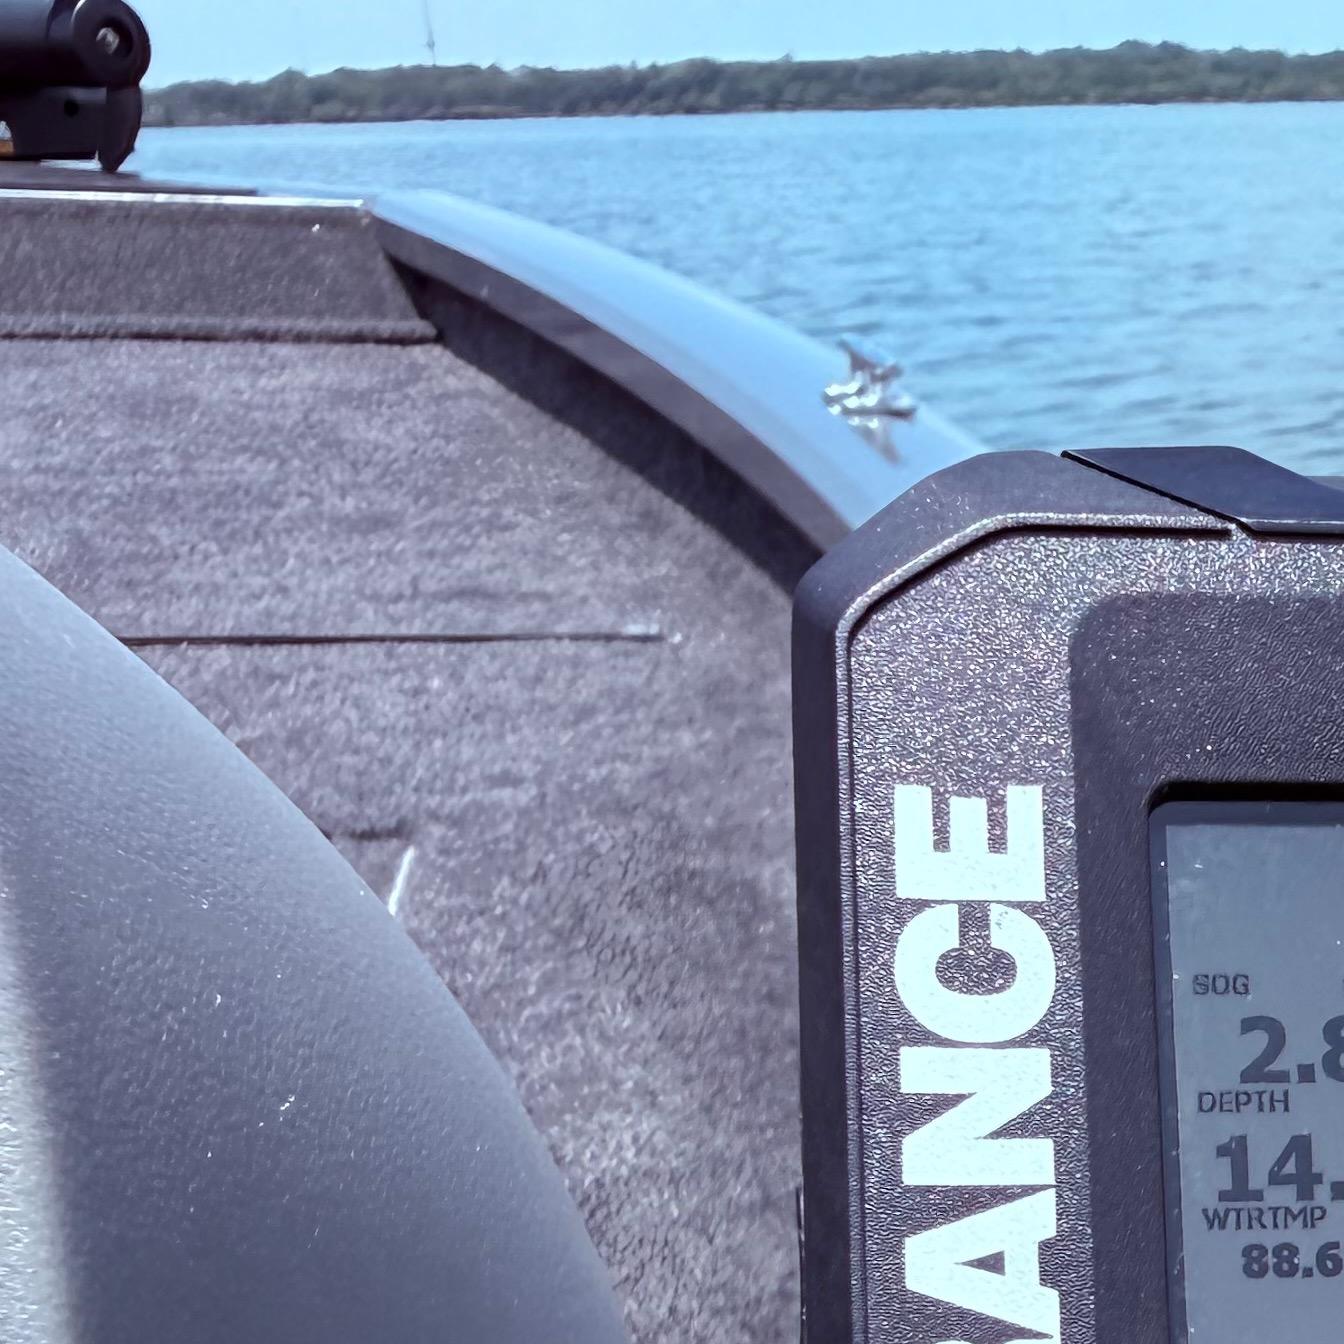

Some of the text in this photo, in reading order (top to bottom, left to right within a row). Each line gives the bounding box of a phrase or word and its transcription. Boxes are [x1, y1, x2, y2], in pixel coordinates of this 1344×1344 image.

[1192, 973, 1250, 996] SOG
[1197, 1088, 1290, 1114] DEPTH
[1201, 1204, 1328, 1231] WTRTMP
[1241, 1240, 1344, 1279] 88.6
